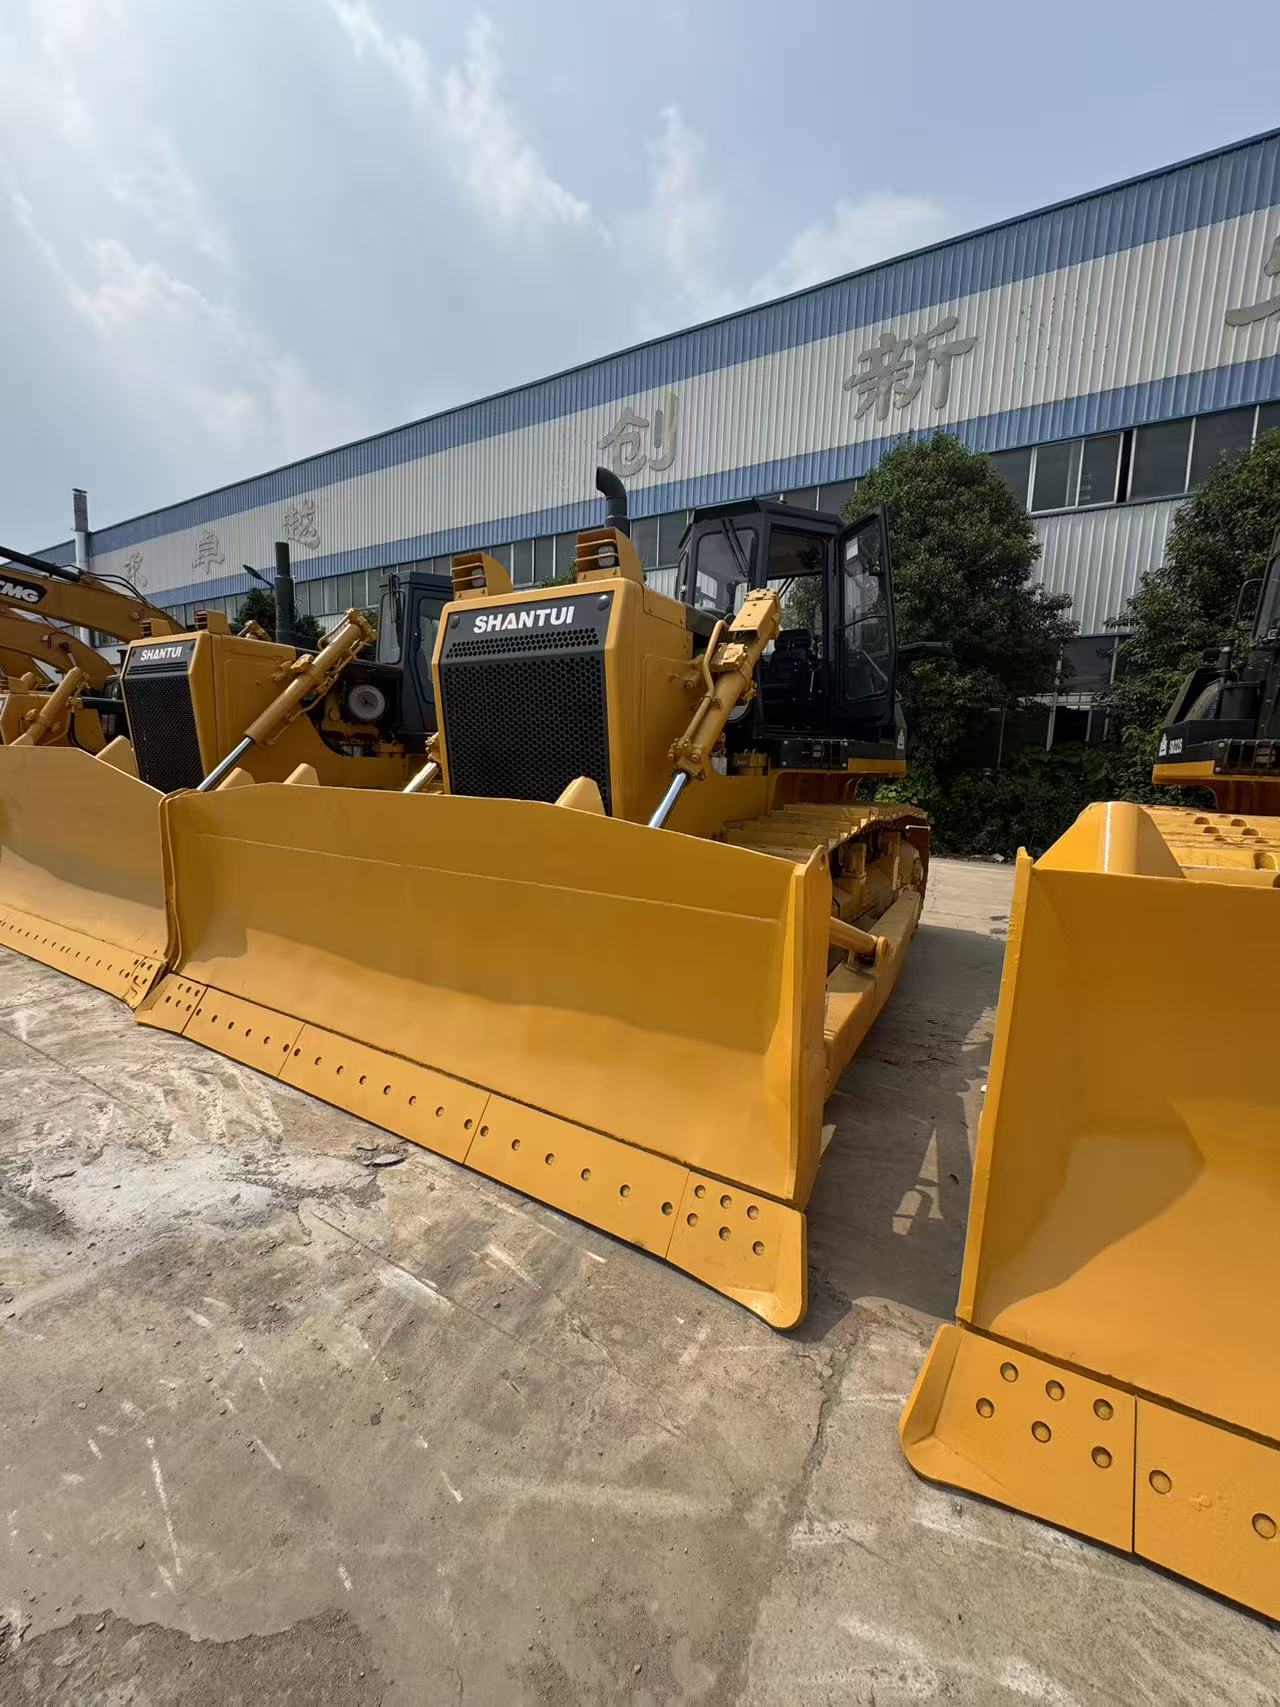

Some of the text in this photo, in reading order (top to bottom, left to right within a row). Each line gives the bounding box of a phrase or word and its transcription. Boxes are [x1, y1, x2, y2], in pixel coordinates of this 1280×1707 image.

[192, 529, 225, 576] 卓
[284, 500, 320, 549] 越
[597, 393, 679, 478] 创
[843, 316, 978, 421] 新
[473, 606, 575, 633] SHANTUI
[140, 646, 182, 661] SHANTUI
